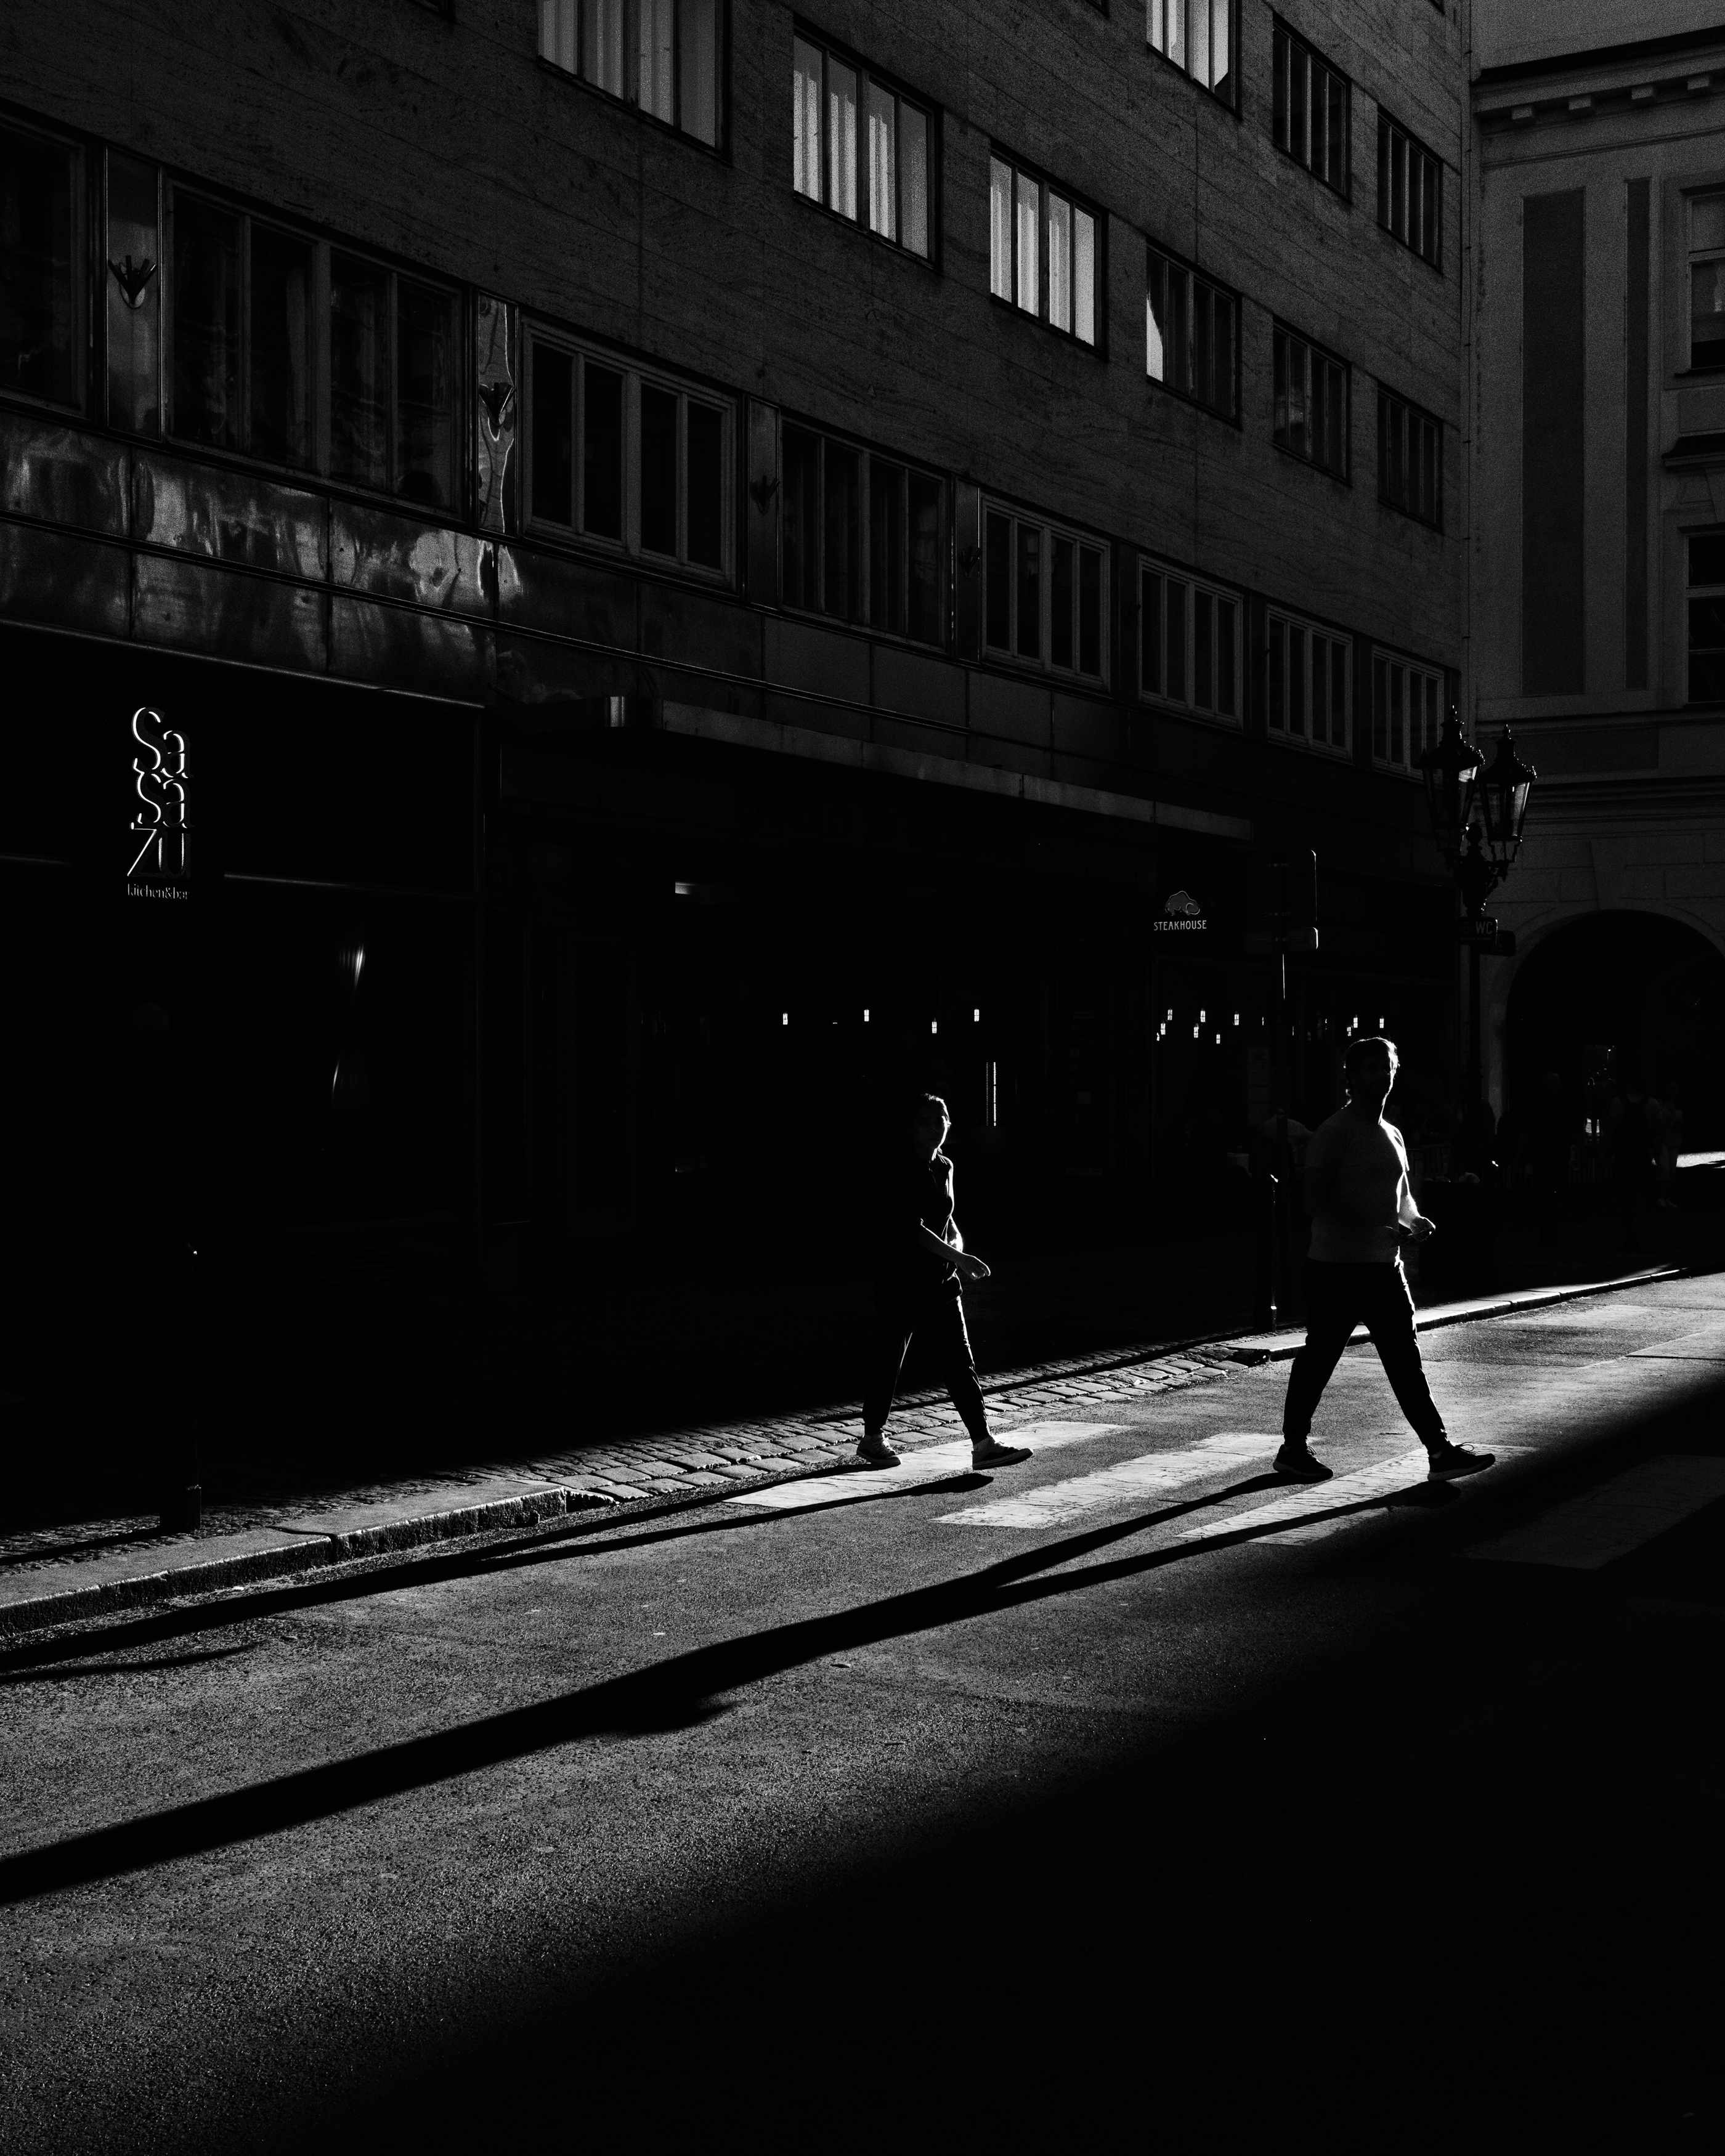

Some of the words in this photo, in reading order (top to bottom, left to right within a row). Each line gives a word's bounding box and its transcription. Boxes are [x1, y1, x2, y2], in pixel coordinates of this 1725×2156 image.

[735, 786, 852, 839] DIVADLO
[908, 814, 1028, 863] BROADWAY
[489, 869, 501, 885] 38
[1153, 920, 1207, 931] STEAKHOUSE
[1475, 921, 1493, 934] WC
[1070, 1024, 1087, 1032] delta
